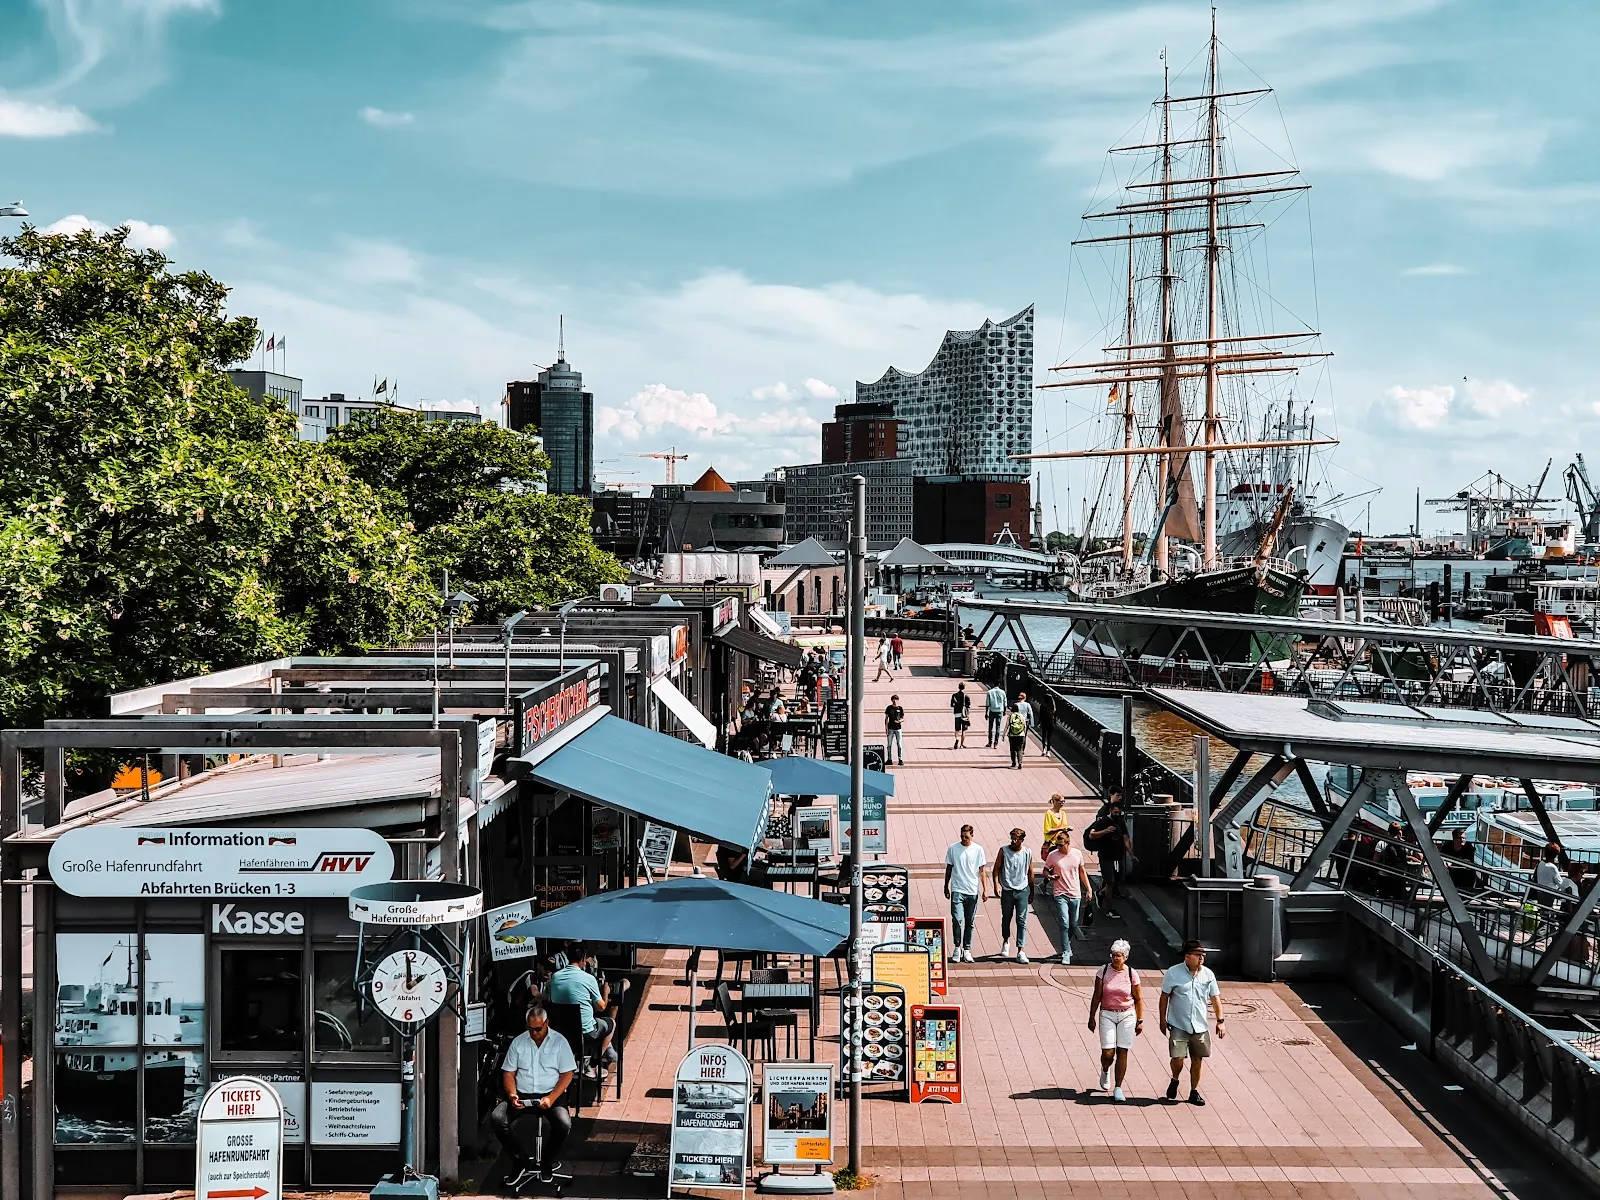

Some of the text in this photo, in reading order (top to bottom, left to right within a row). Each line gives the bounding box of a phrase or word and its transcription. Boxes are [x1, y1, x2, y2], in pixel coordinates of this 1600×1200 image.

[1430, 812, 1476, 820] INER
[170, 832, 264, 846] Information
[62, 860, 203, 872] Große Hafenrundfahrt
[239, 857, 371, 872] Hafenfähren im HVV
[140, 882, 296, 894] Abfahrten Brücken 1-3
[534, 884, 584, 892] Cappuccino
[388, 904, 418, 914] Große
[540, 900, 572, 909] Espre
[212, 903, 305, 935] Kasse
[371, 914, 444, 924] Hafenrundfahrt
[403, 952, 417, 963] 12
[374, 981, 443, 992] 9 3
[404, 1009, 413, 1020] 6
[700, 1054, 727, 1066] INFOS
[700, 1067, 725, 1078] HIER!
[221, 1090, 262, 1102] TICKETS
[227, 1104, 255, 1116] HIER!
[680, 1119, 740, 1129] HAFENRUNDFAHRT
[227, 1134, 254, 1147] GROSSE
[209, 1149, 270, 1163] HAFENRUNDFAHRT
[682, 1154, 735, 1164] TICKETS HIER!
[208, 1172, 222, 1182] (auch
[233, 1170, 271, 1181] Speicherstadt)
